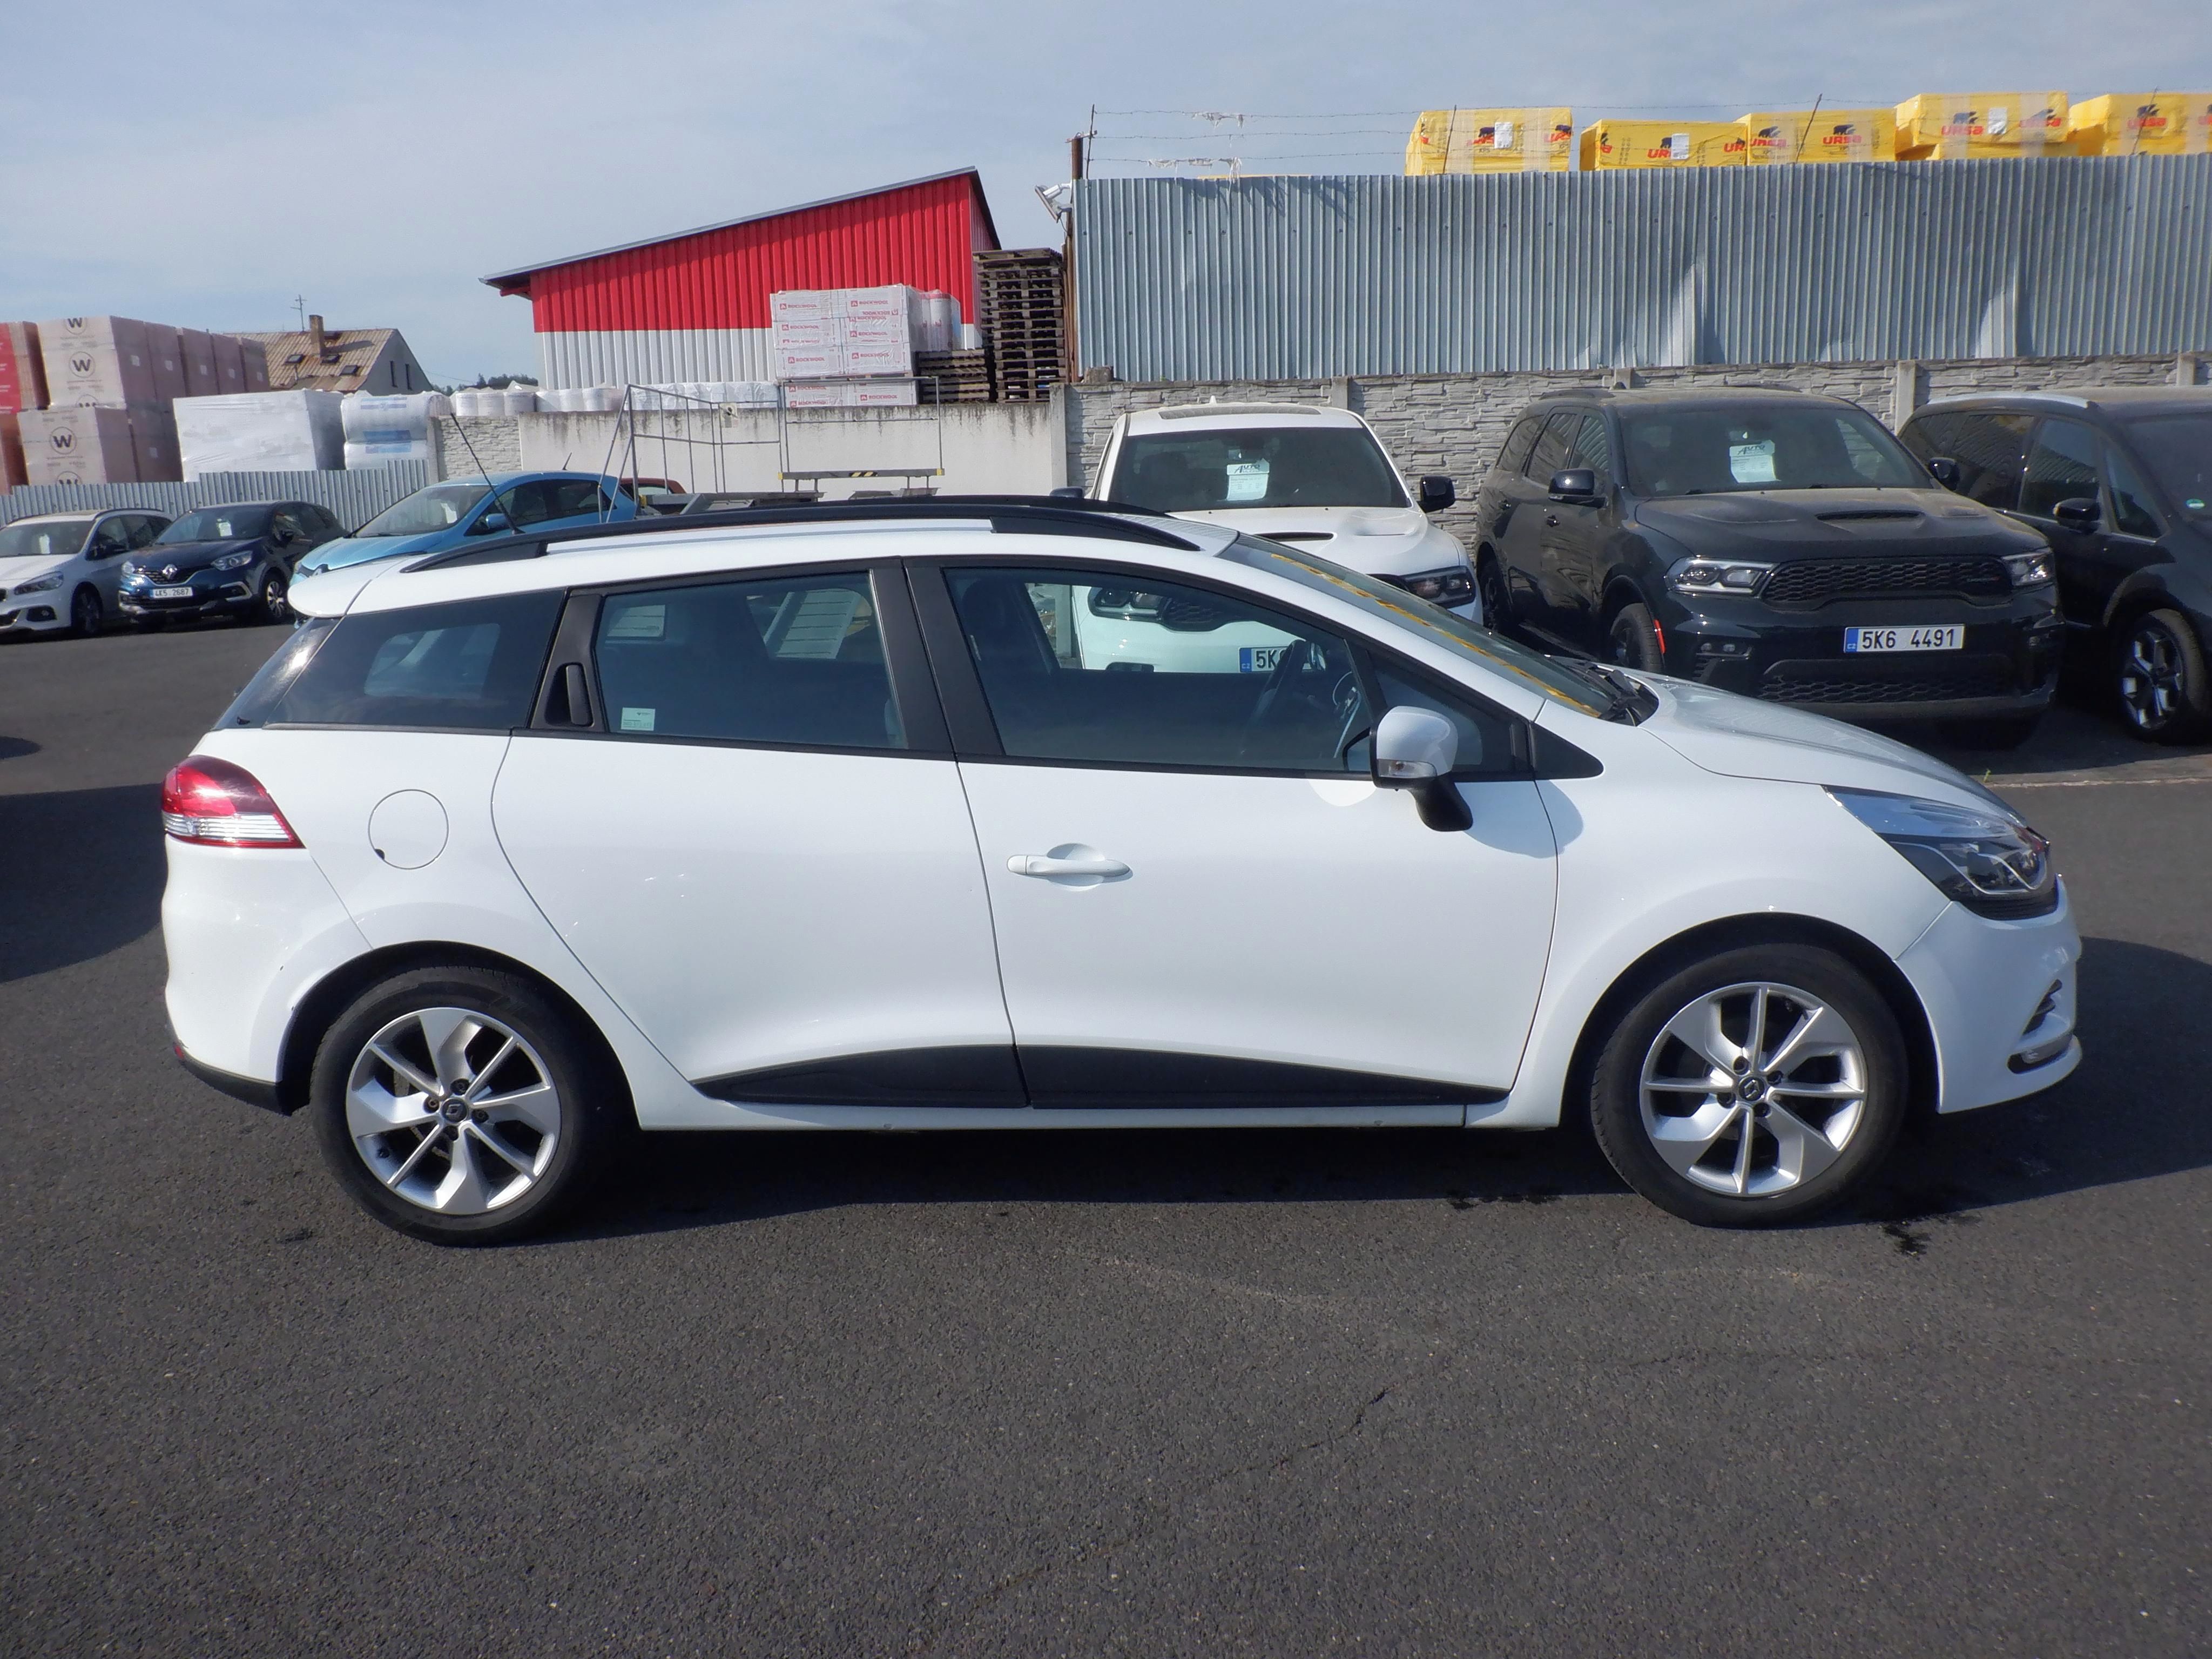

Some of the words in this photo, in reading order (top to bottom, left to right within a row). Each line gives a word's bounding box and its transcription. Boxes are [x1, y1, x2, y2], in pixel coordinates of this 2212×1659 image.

[72, 359, 91, 372] W
[53, 434, 72, 448] W
[172, 588, 189, 596] 2687
[1862, 631, 1897, 649] 5K6
[1910, 628, 1954, 648] 4491
[1256, 650, 1288, 669] 5K
